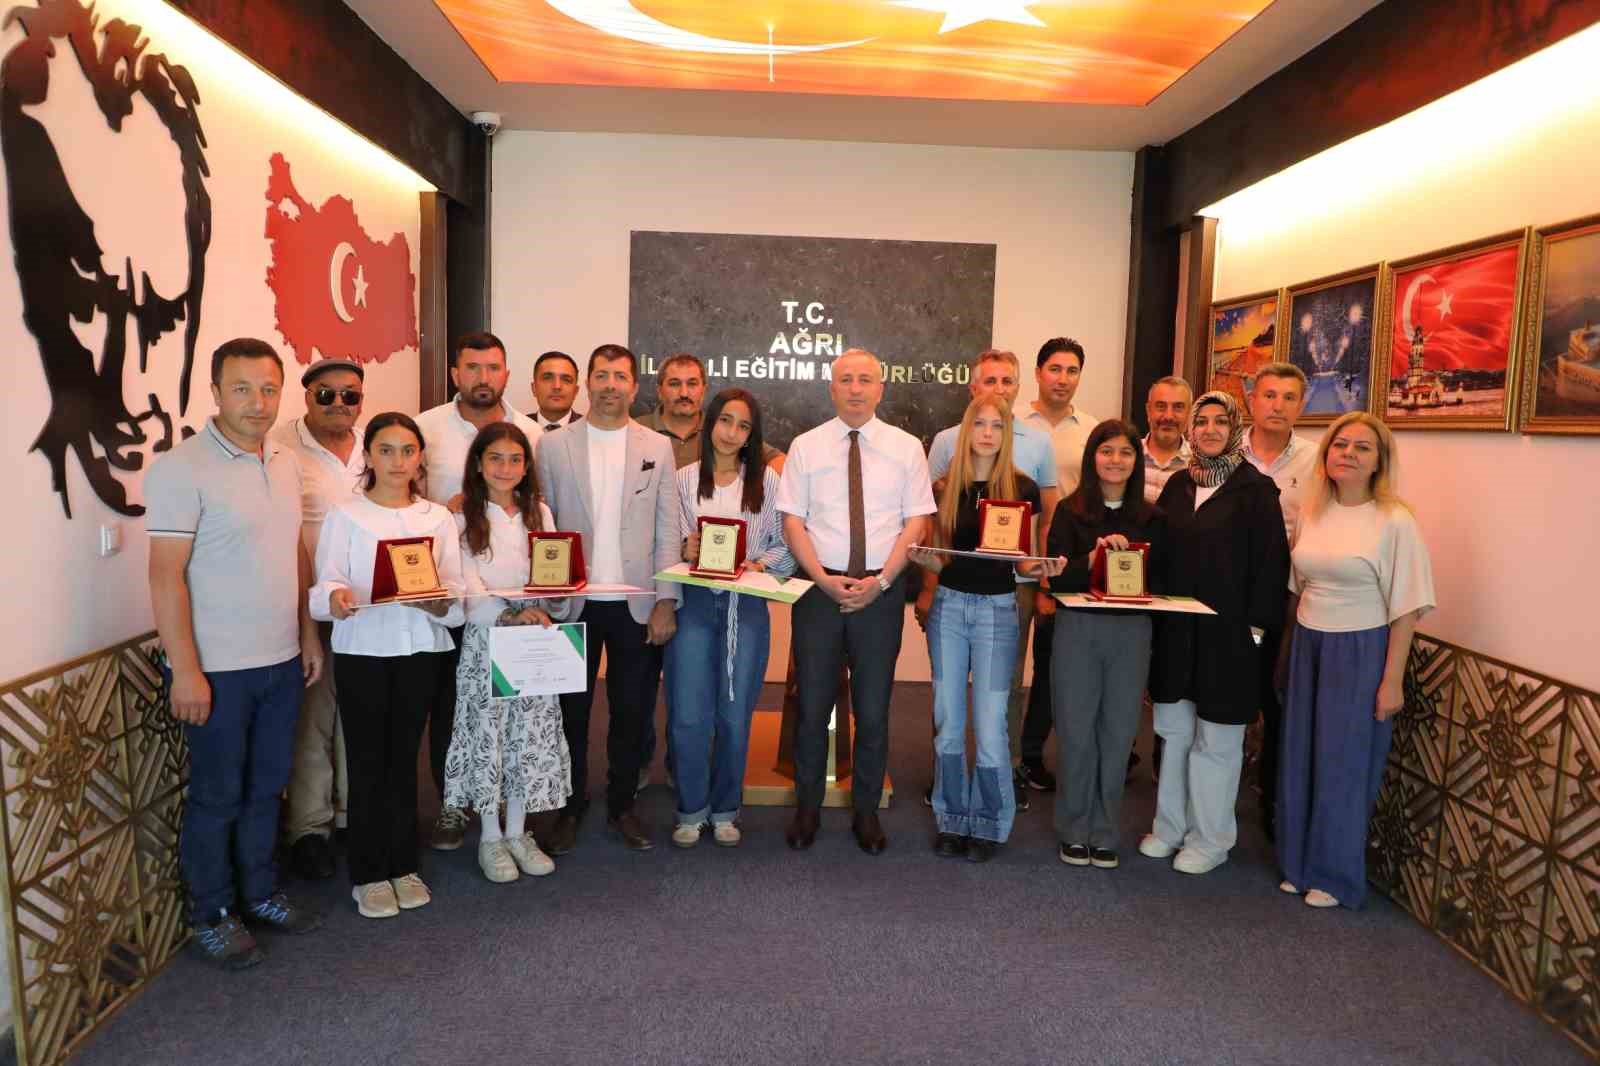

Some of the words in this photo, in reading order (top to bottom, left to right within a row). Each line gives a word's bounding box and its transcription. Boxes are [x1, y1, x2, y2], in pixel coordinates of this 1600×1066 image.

[781, 301, 833, 324] T.C.
[769, 328, 843, 356] AĞRI
[735, 355, 815, 380] EĞİTİM
